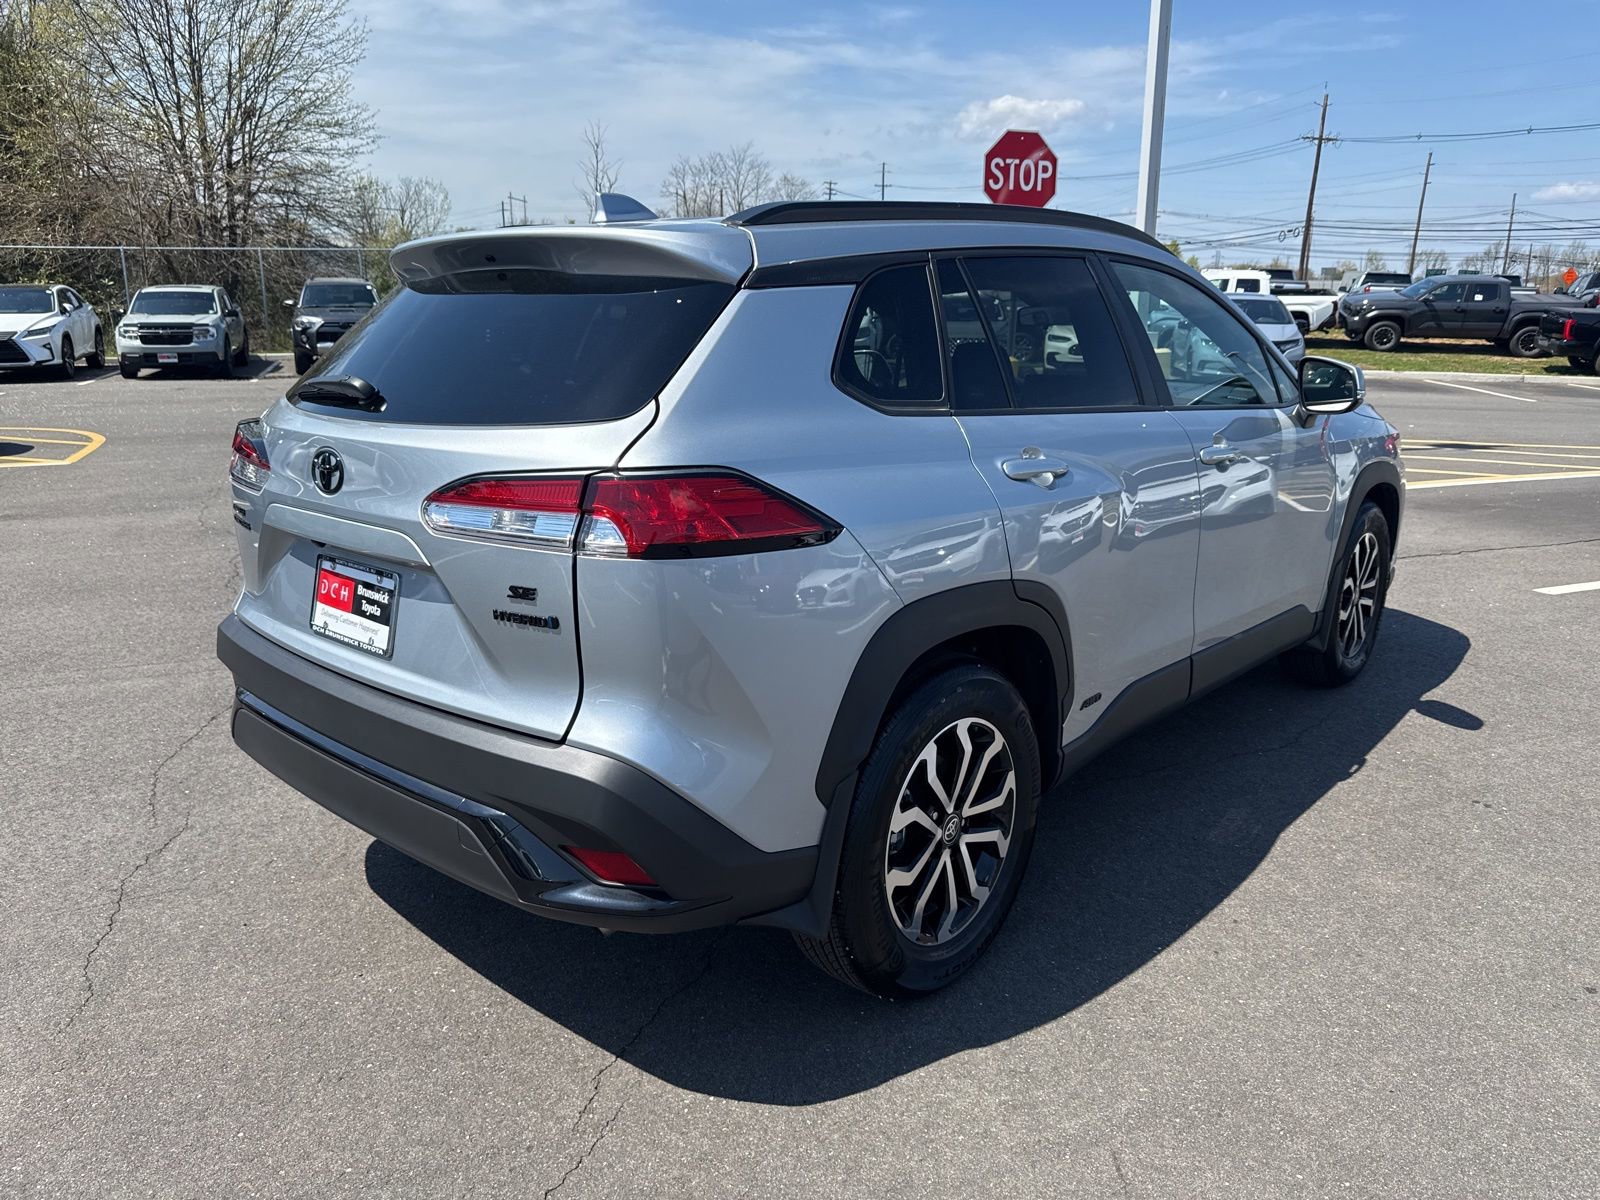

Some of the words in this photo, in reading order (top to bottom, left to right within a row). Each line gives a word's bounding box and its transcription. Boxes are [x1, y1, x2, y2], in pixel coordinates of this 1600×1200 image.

[988, 157, 1053, 192] STOP
[320, 579, 349, 602] DCH
[357, 584, 390, 604] Brunswick
[361, 600, 381, 617] Toyota
[492, 608, 548, 628] HYBRID
[325, 628, 359, 647] BRUNSWICK
[359, 642, 384, 656] TOYOTA
